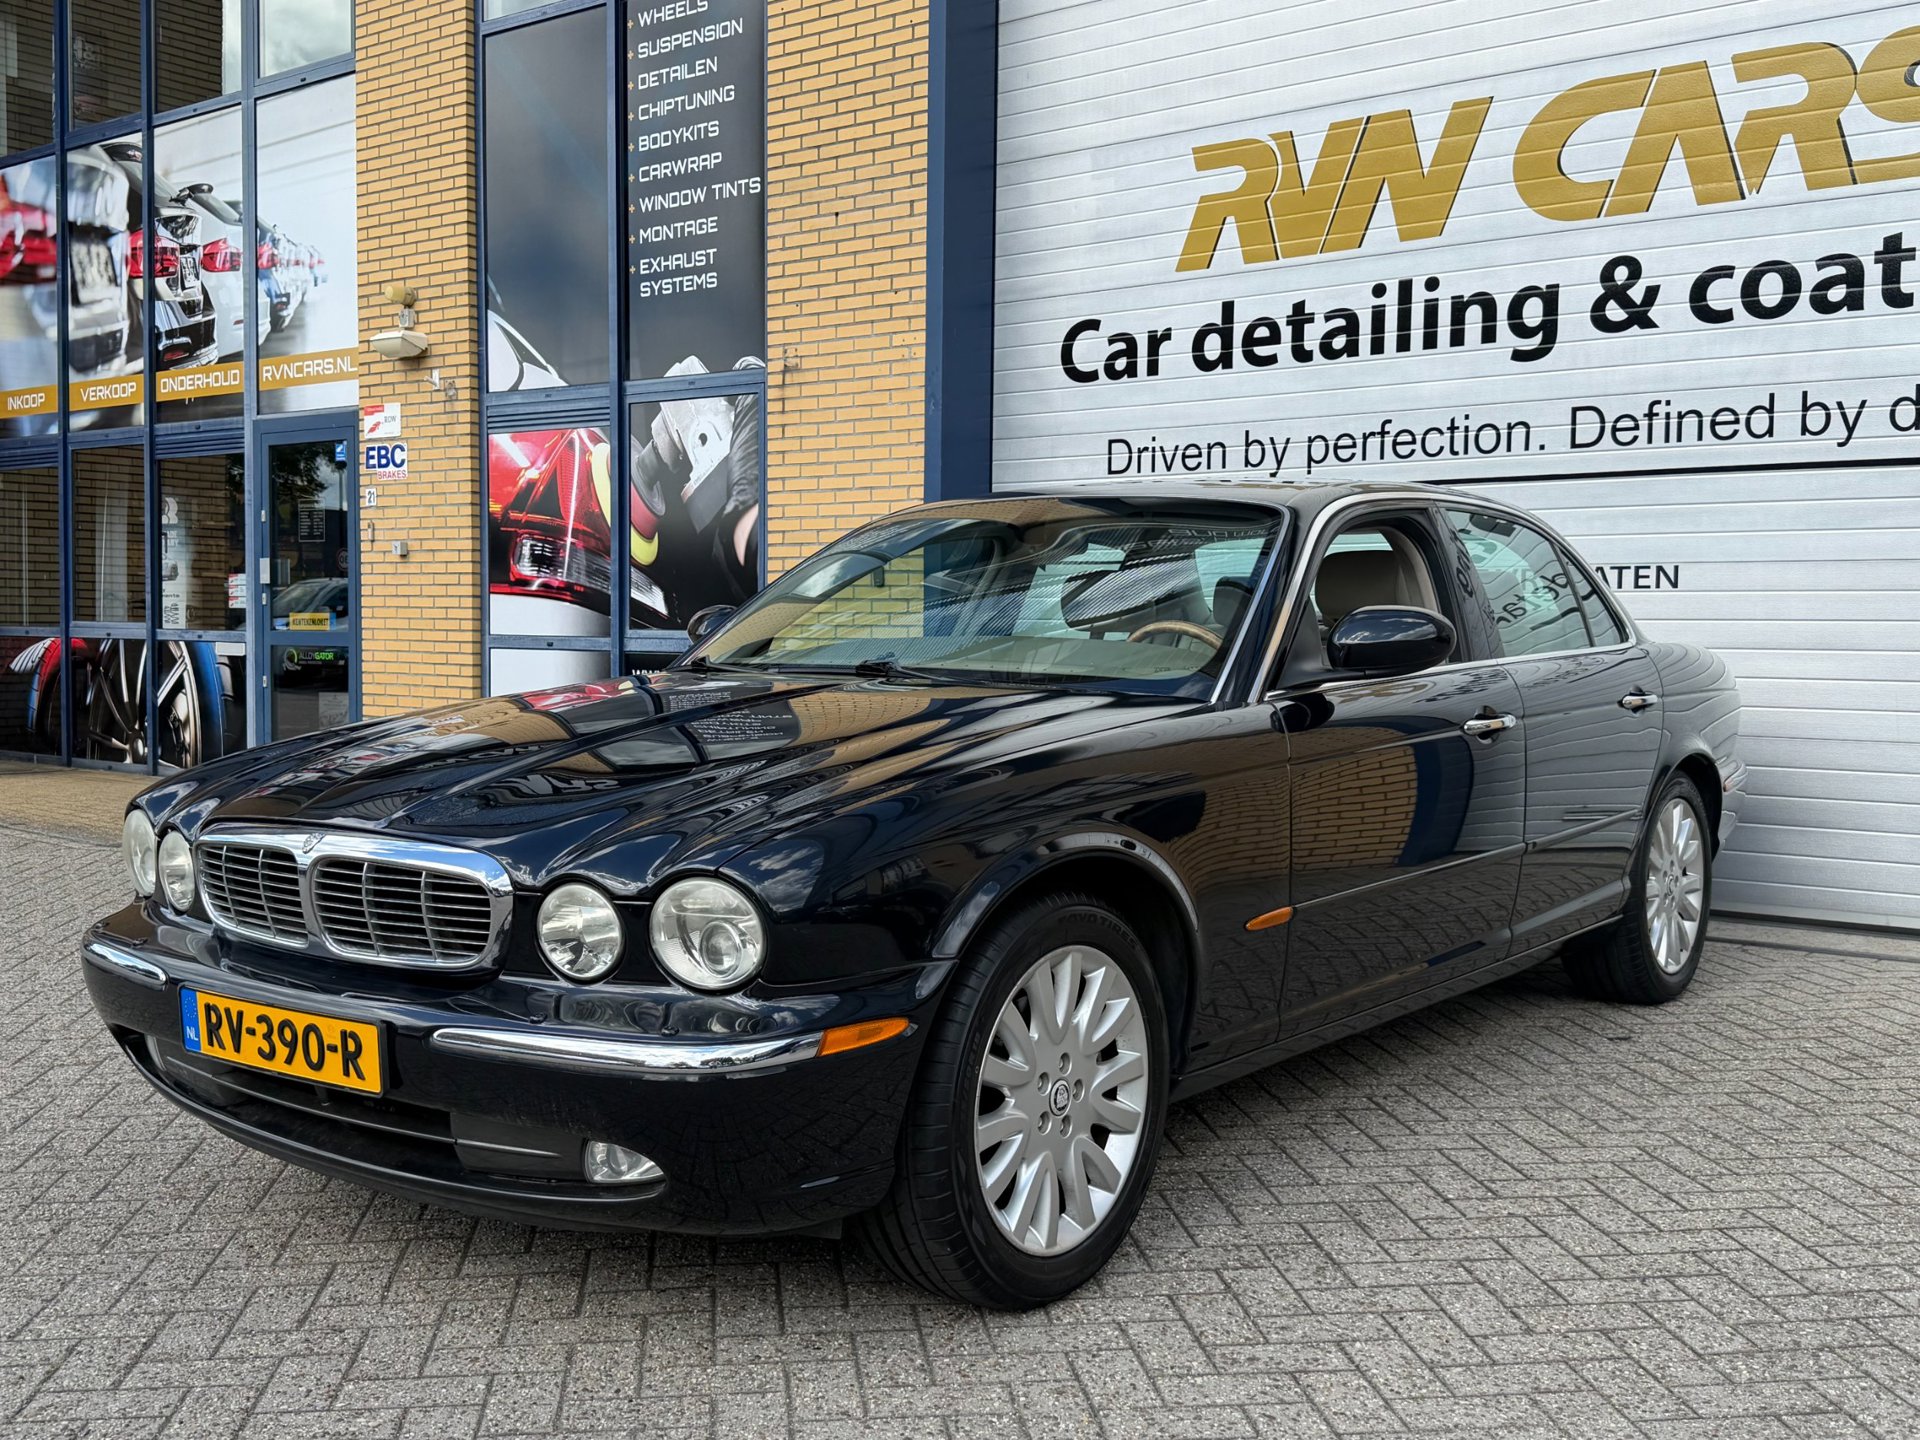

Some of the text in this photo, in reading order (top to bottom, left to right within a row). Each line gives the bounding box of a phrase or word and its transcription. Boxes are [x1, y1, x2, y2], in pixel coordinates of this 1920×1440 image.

[638, 0, 709, 27] WHEELS
[638, 17, 743, 59] SUSPENSION
[638, 56, 718, 90] DETAILEN
[638, 85, 735, 121] CHIPTUNING
[638, 120, 720, 151] BODYKITS
[639, 152, 722, 183] CARWRAP
[639, 177, 761, 213] WINDOW TINTS
[1175, 95, 1494, 272] RVN
[639, 216, 718, 244] MONTAGE
[640, 248, 717, 275] EXHAUST
[640, 272, 718, 297] SYSTEMS
[1061, 231, 1917, 383] Car detailing & coat
[160, 368, 240, 394] ONDERHOUD
[262, 356, 358, 382] RVNCARS.NL
[7, 392, 46, 411] INKOOP
[80, 381, 137, 402] VERKOOP
[1107, 436, 1227, 475] Driven
[1244, 430, 1291, 478] by
[1306, 414, 1546, 474] perfection.
[1570, 392, 1775, 449] Defined
[1800, 390, 1867, 447] by
[365, 443, 406, 470] EBC
[377, 469, 407, 480] BRAKES
[186, 1025, 199, 1042] NL
[204, 1001, 367, 1082] RV-390-R
